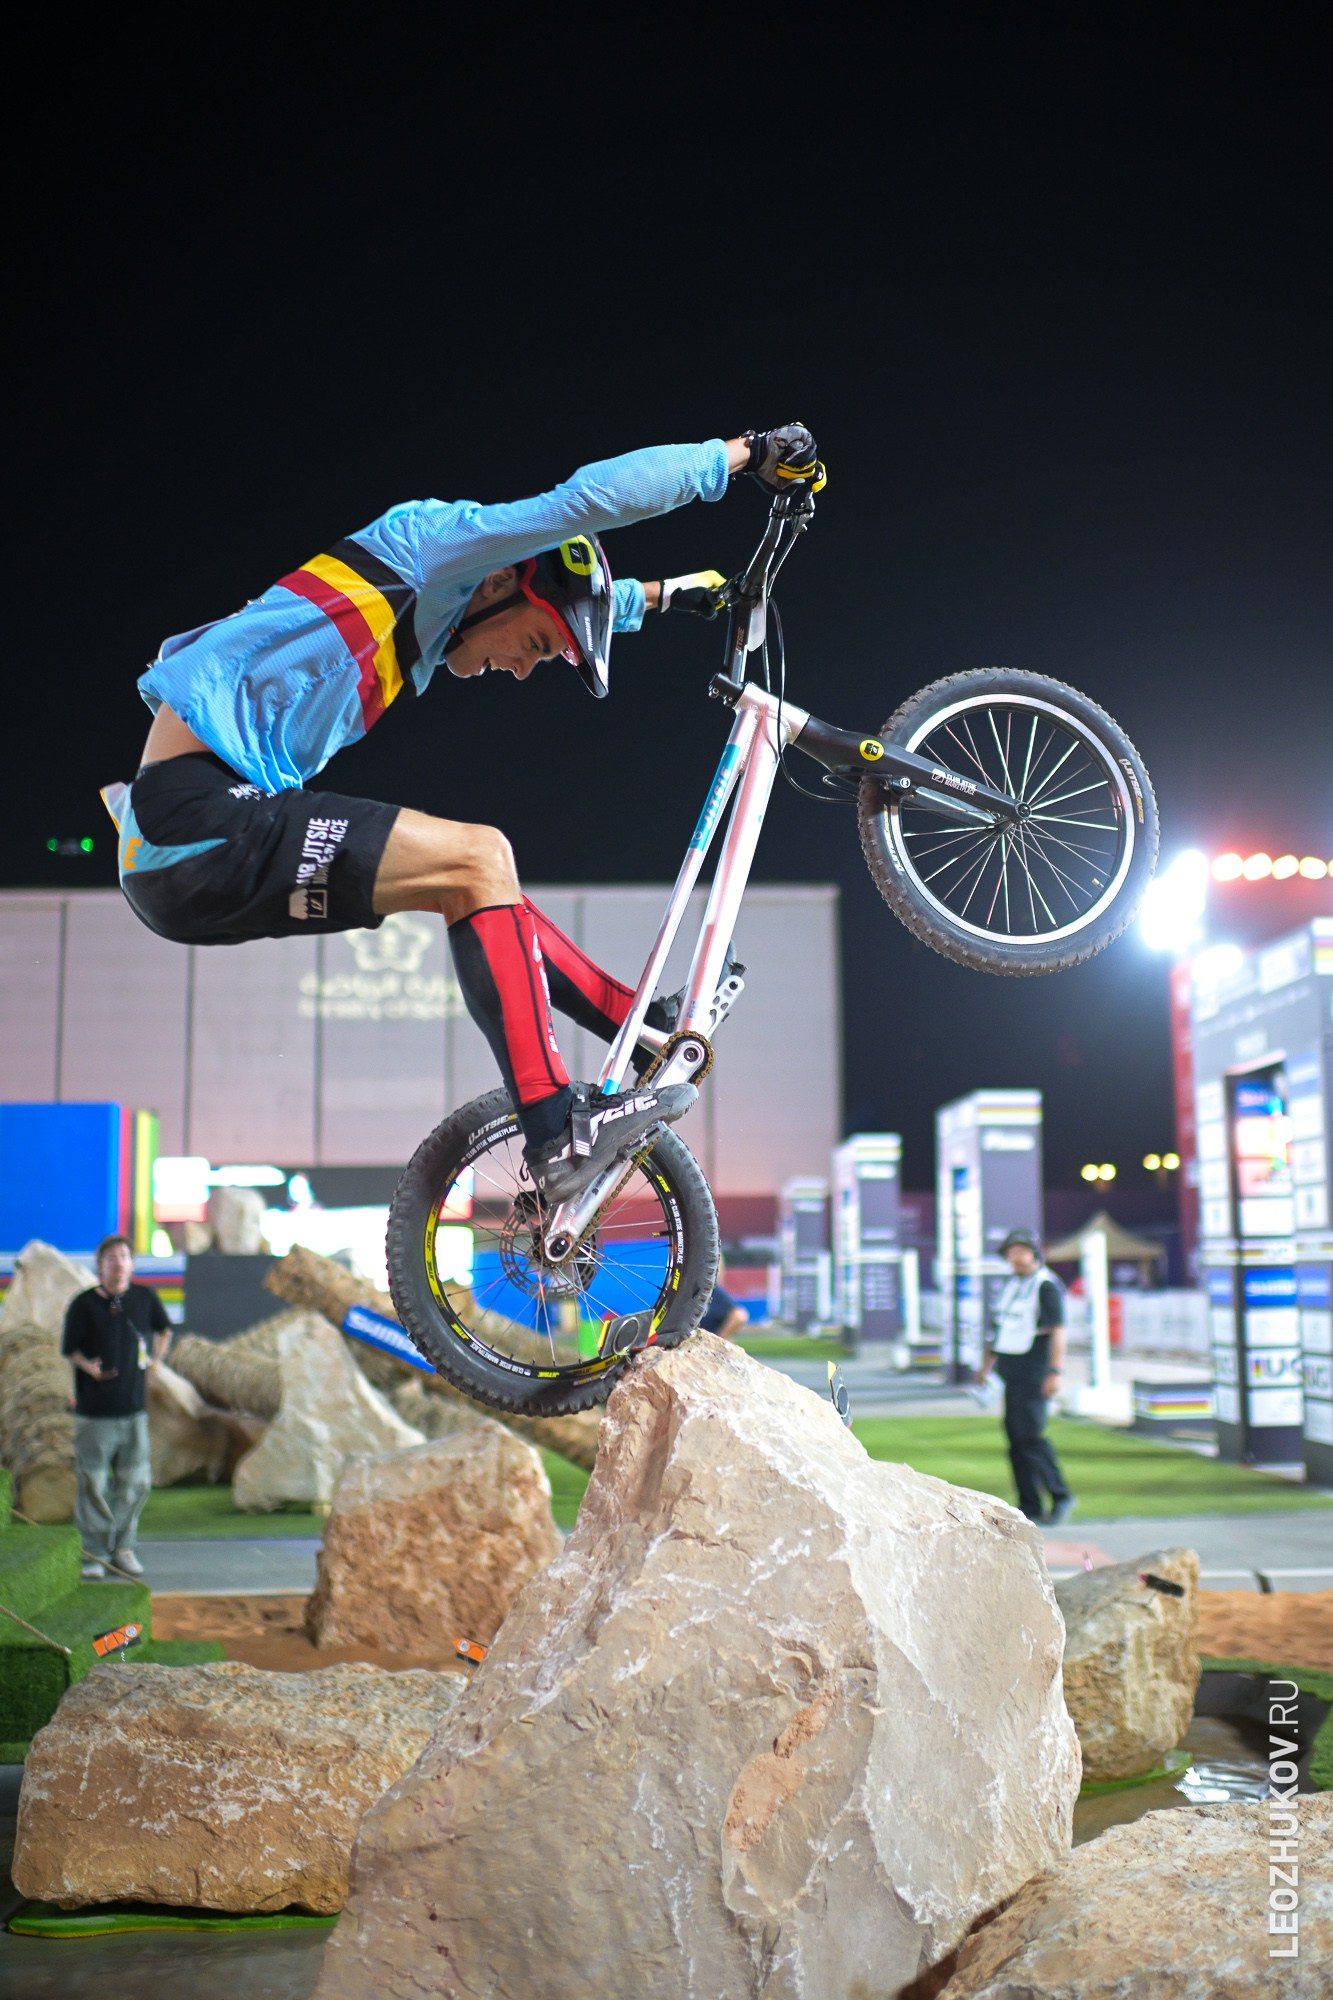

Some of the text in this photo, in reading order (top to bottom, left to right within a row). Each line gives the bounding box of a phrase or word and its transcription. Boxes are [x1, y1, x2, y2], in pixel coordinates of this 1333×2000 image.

[705, 766, 731, 830] JITSIE
[301, 818, 330, 863] JITSIE
[475, 1114, 509, 1140] JITSIE
[487, 1124, 518, 1143] MARKETPLACE
